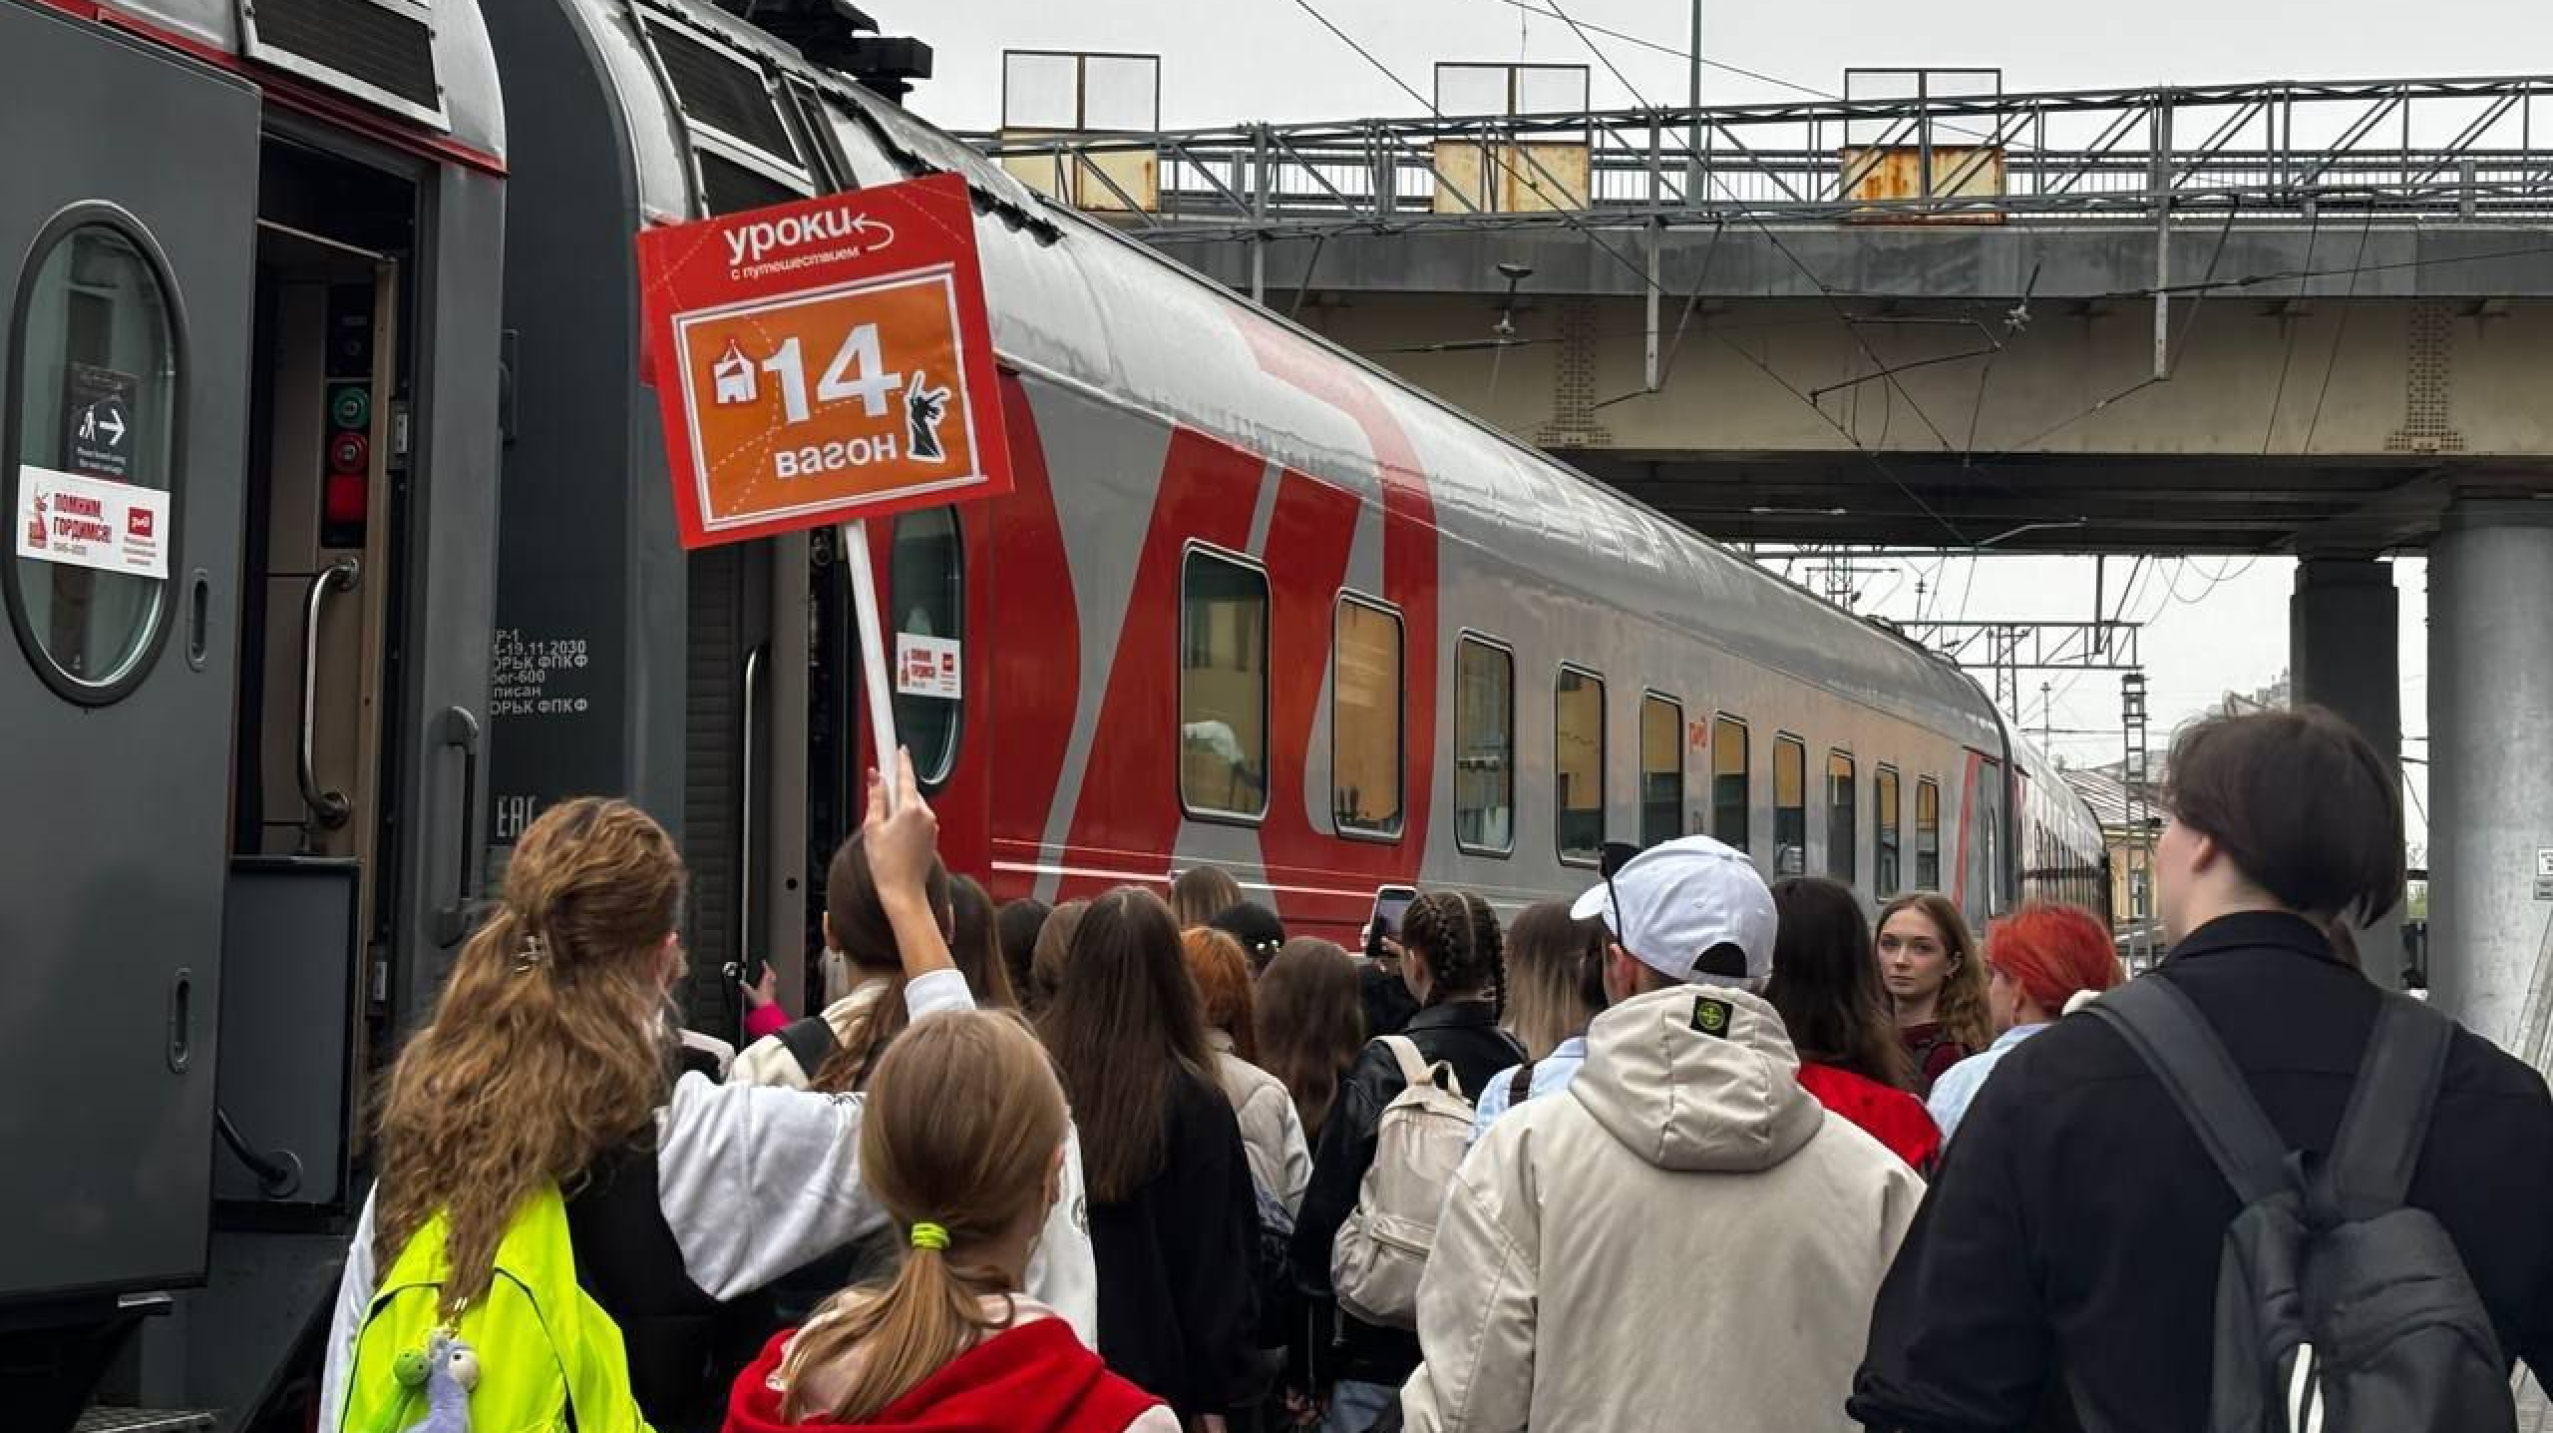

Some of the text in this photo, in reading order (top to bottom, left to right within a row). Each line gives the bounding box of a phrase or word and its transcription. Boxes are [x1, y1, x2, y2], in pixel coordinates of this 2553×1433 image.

[724, 206, 852, 266] уроки
[731, 246, 860, 281] с путешествием
[762, 323, 902, 424] 14
[775, 433, 898, 479] вагон
[538, 654, 589, 669] ФПКФ
[538, 698, 589, 713] ФПКФ
